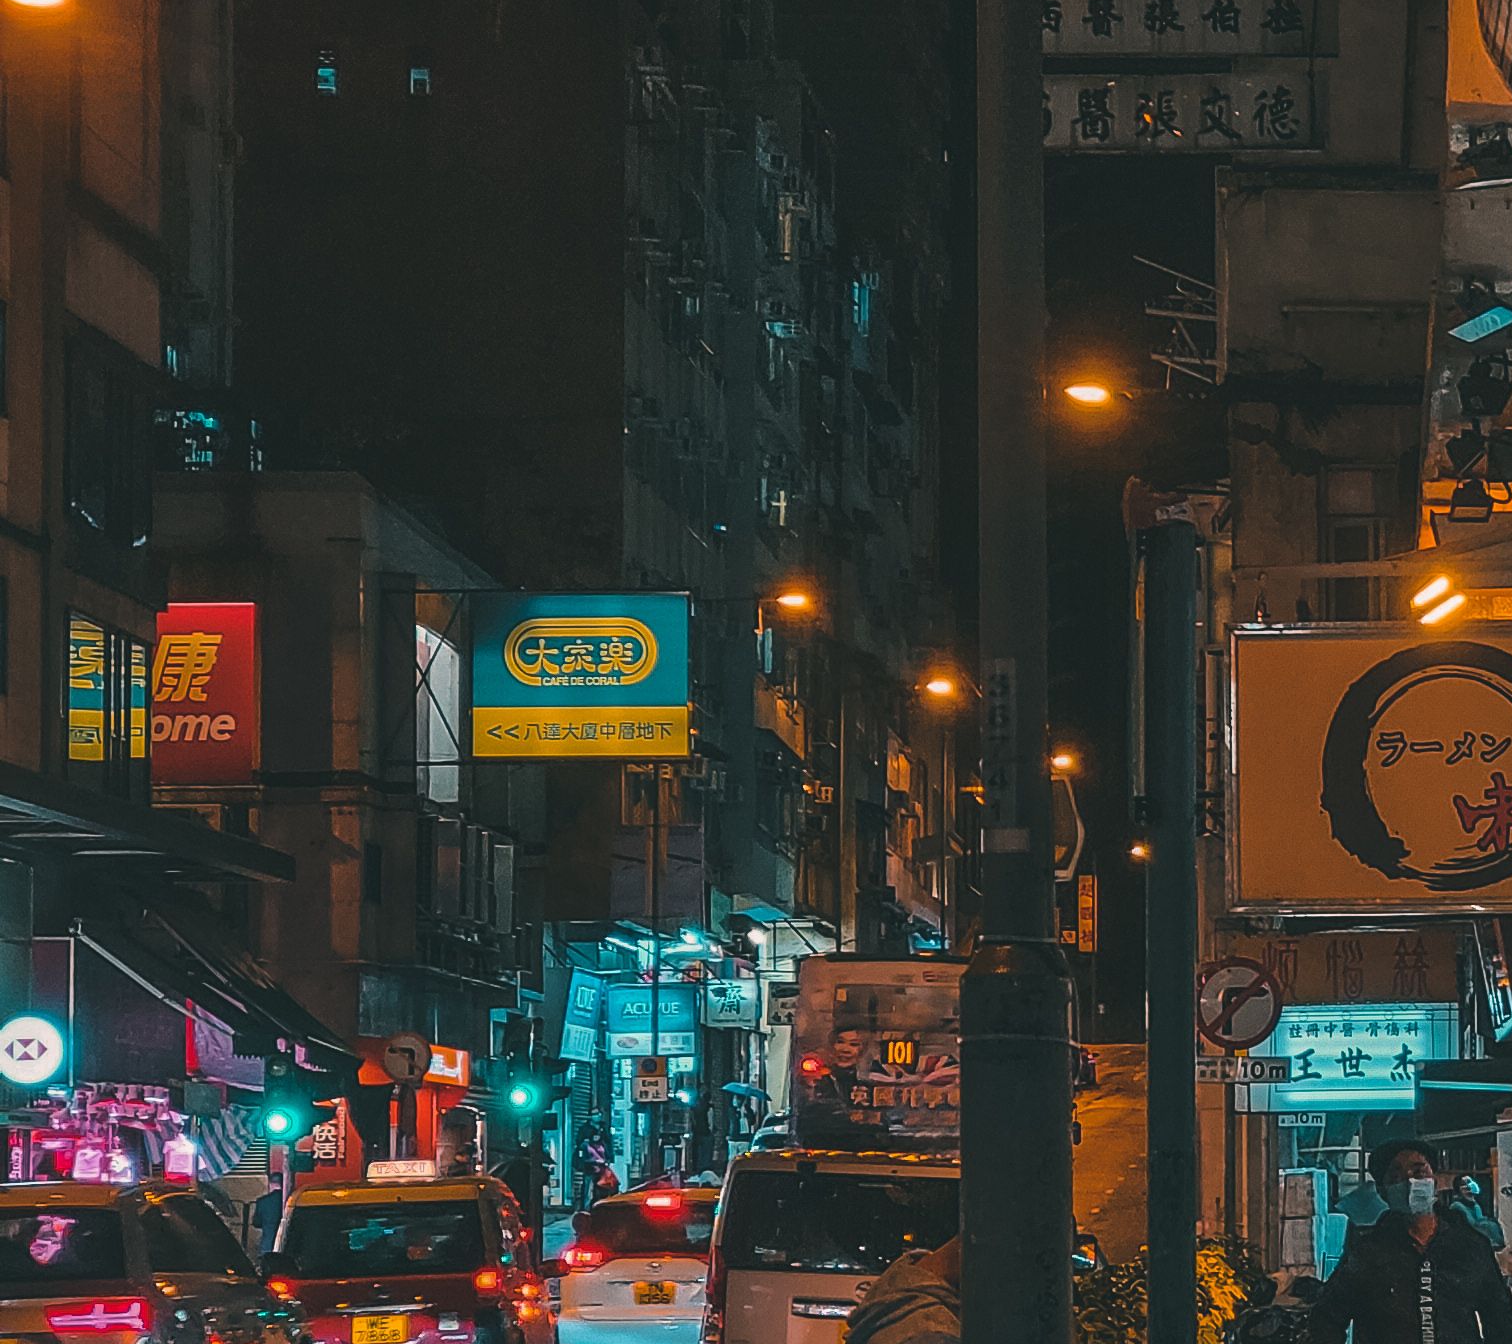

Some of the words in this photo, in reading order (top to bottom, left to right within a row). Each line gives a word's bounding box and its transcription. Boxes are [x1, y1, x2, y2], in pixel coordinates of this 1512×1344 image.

[151, 632, 224, 702] 康
[542, 674, 569, 686] CAFÉ
[571, 676, 584, 686] DE
[585, 676, 620, 686] CORAL
[523, 721, 674, 741] 八達大廈中層地下
[1375, 730, 1512, 769] ラーメン
[622, 1002, 680, 1015] ACUUE
[887, 1040, 913, 1066] 101
[1289, 1043, 1417, 1083] 王世杰
[312, 1124, 337, 1159] 快活
[374, 1162, 427, 1174] TAXI
